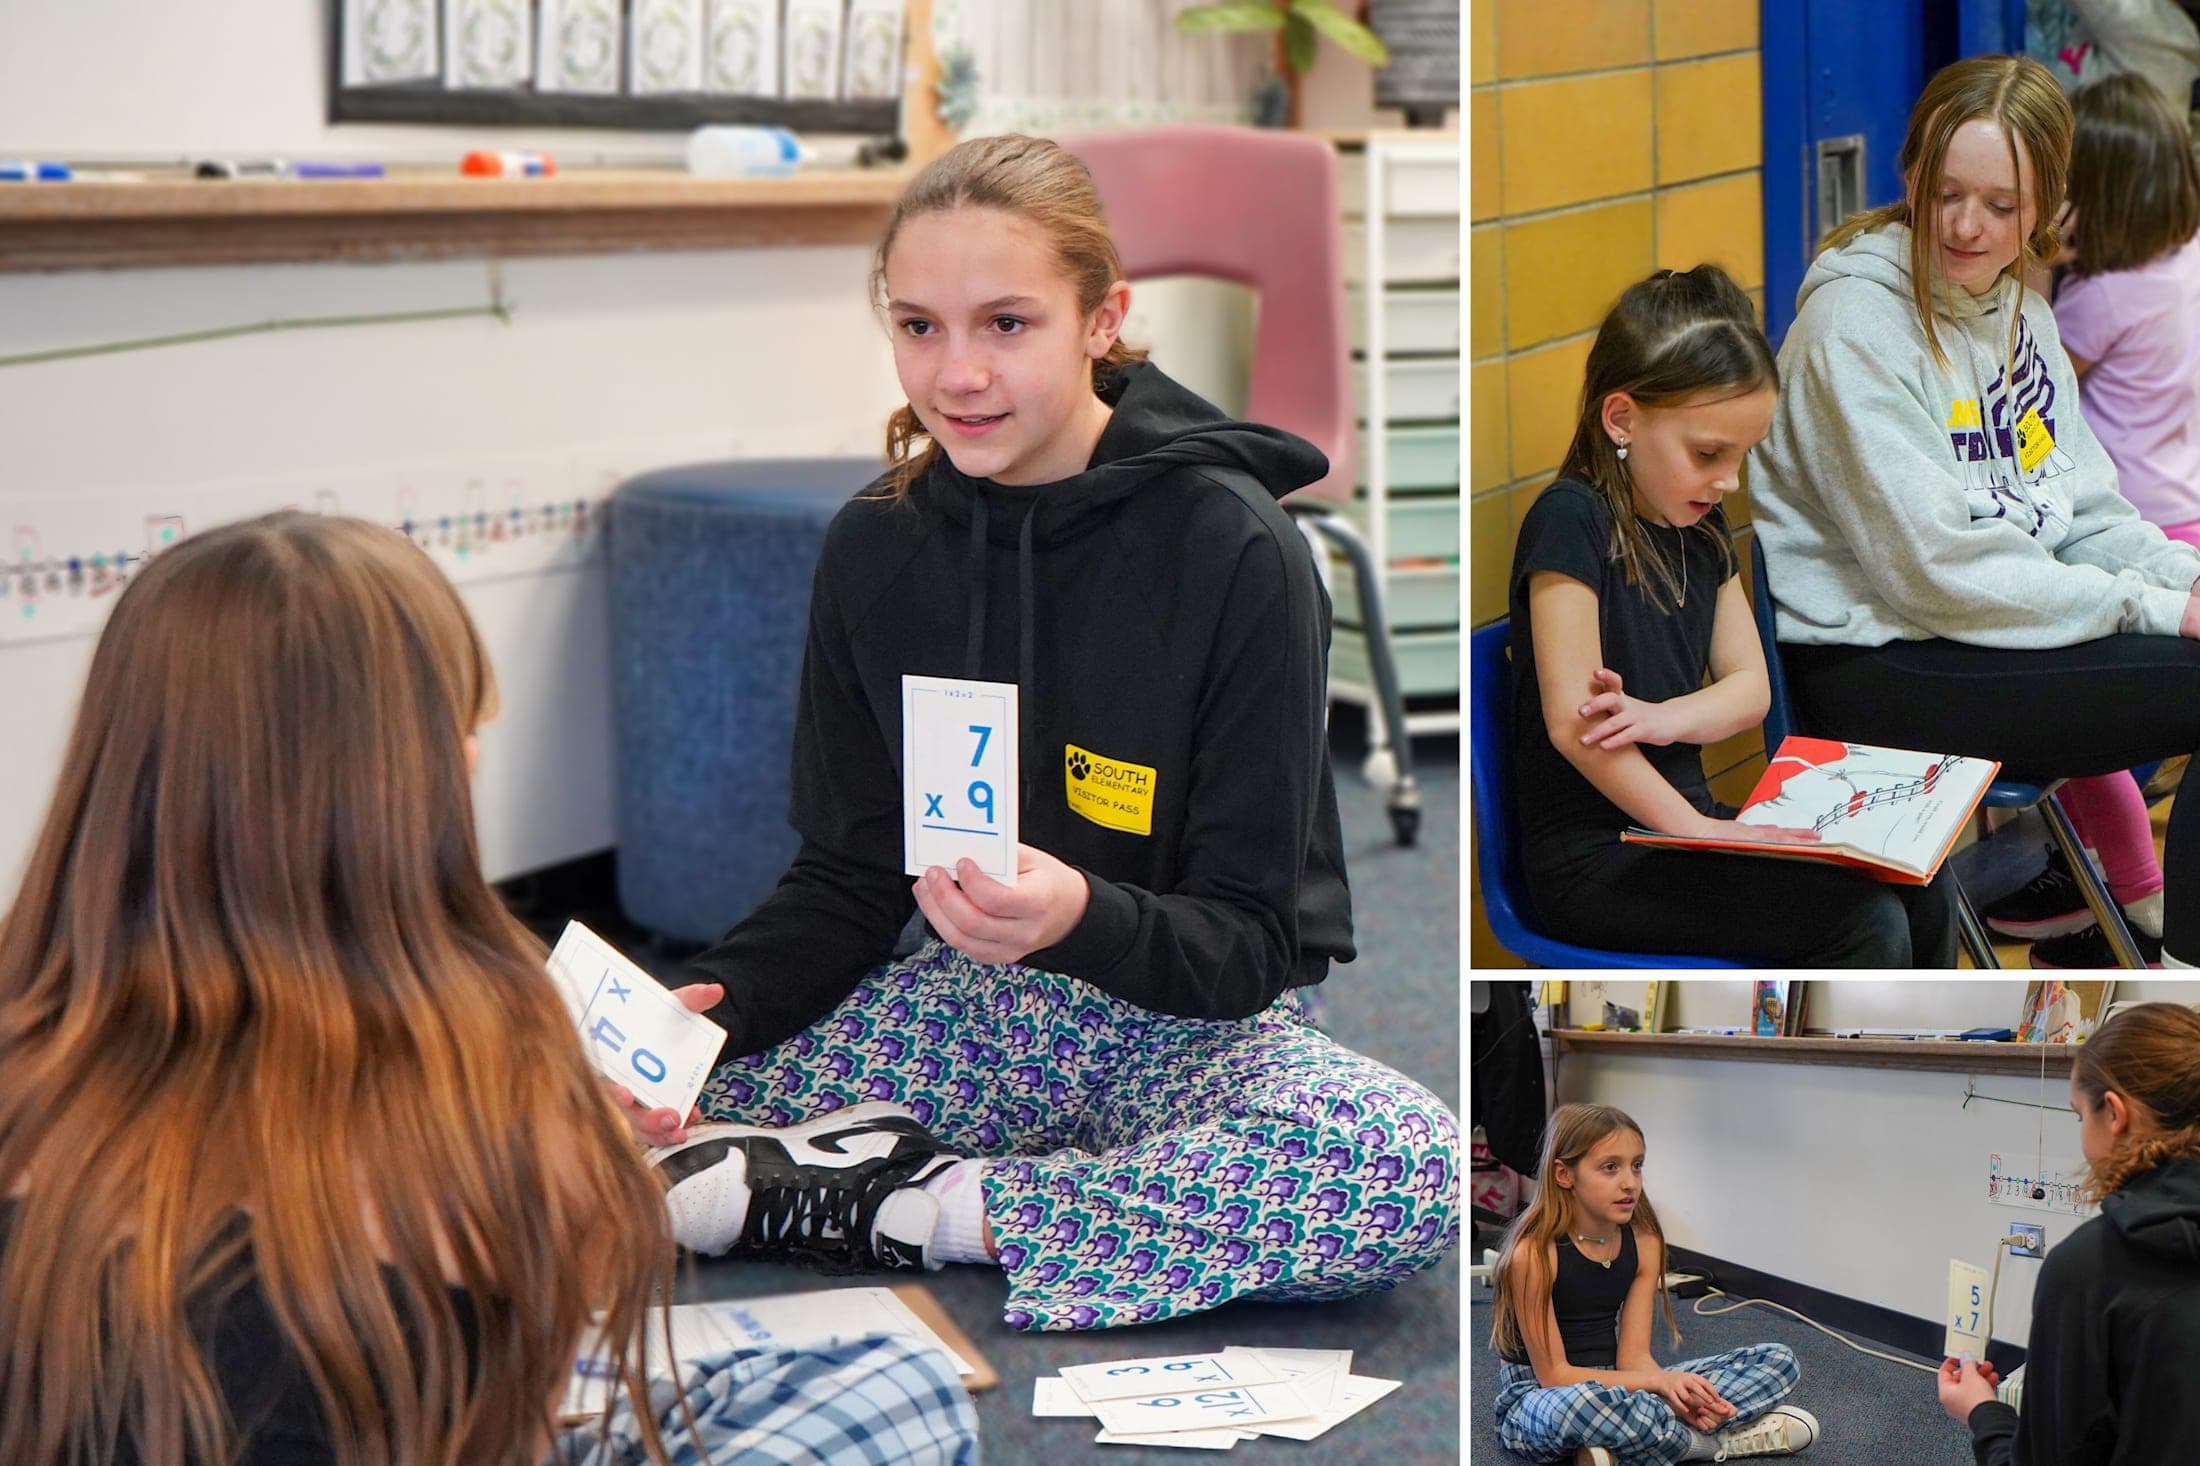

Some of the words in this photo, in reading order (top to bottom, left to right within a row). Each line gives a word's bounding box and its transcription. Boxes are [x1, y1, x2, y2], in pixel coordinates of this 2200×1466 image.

[968, 725, 993, 768] 7
[1093, 762, 1148, 786] SOUTH
[1091, 775, 1149, 797] ELEMENTARY
[967, 780, 994, 824] 9
[1073, 787, 1110, 807] VISITOR
[1113, 801, 1140, 815] PASS
[1971, 1284, 1980, 1307] 5
[1971, 1311, 1980, 1332] 7
[1107, 1366, 1150, 1377] 3
[1163, 1360, 1204, 1372] 9
